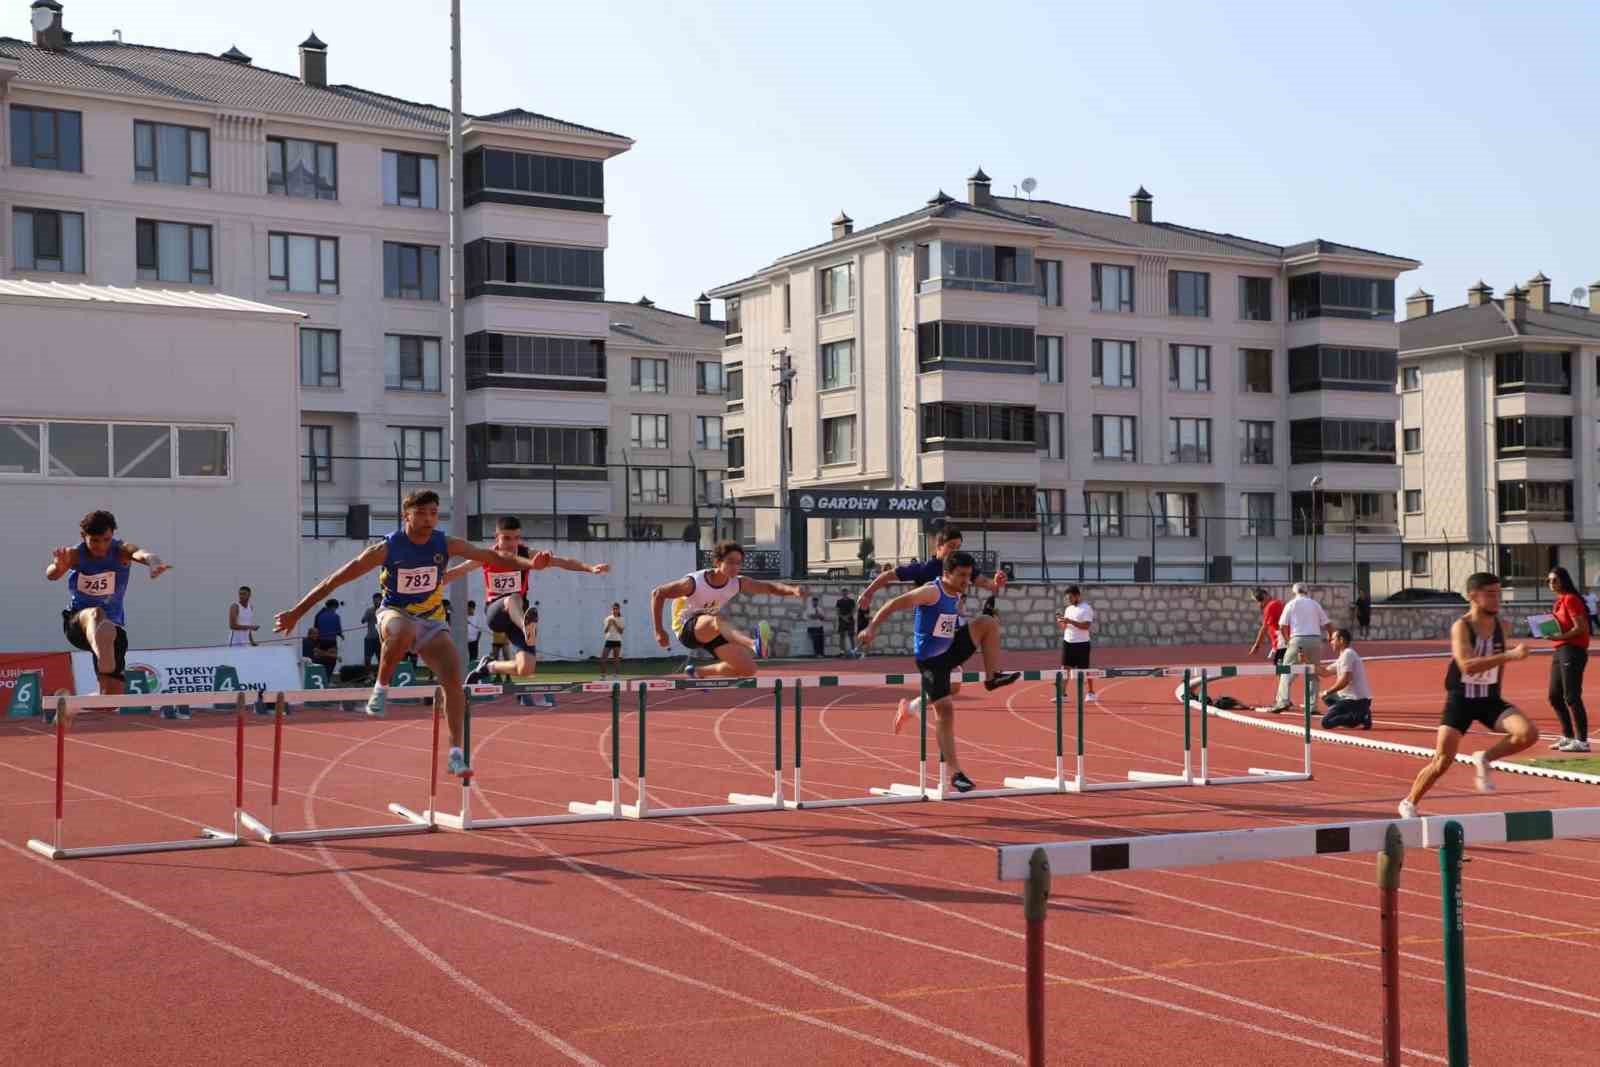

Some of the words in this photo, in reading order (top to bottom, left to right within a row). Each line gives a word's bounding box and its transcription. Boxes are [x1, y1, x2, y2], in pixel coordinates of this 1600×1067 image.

[817, 496, 878, 510] GARDEN
[888, 496, 928, 511] PARK
[84, 578, 108, 591] 745
[405, 574, 430, 588] 782
[494, 577, 515, 589] 873
[129, 679, 142, 694] 5
[219, 677, 236, 691] 4
[311, 674, 324, 689] 3
[398, 672, 411, 688] 2
[17, 682, 32, 702] 6
